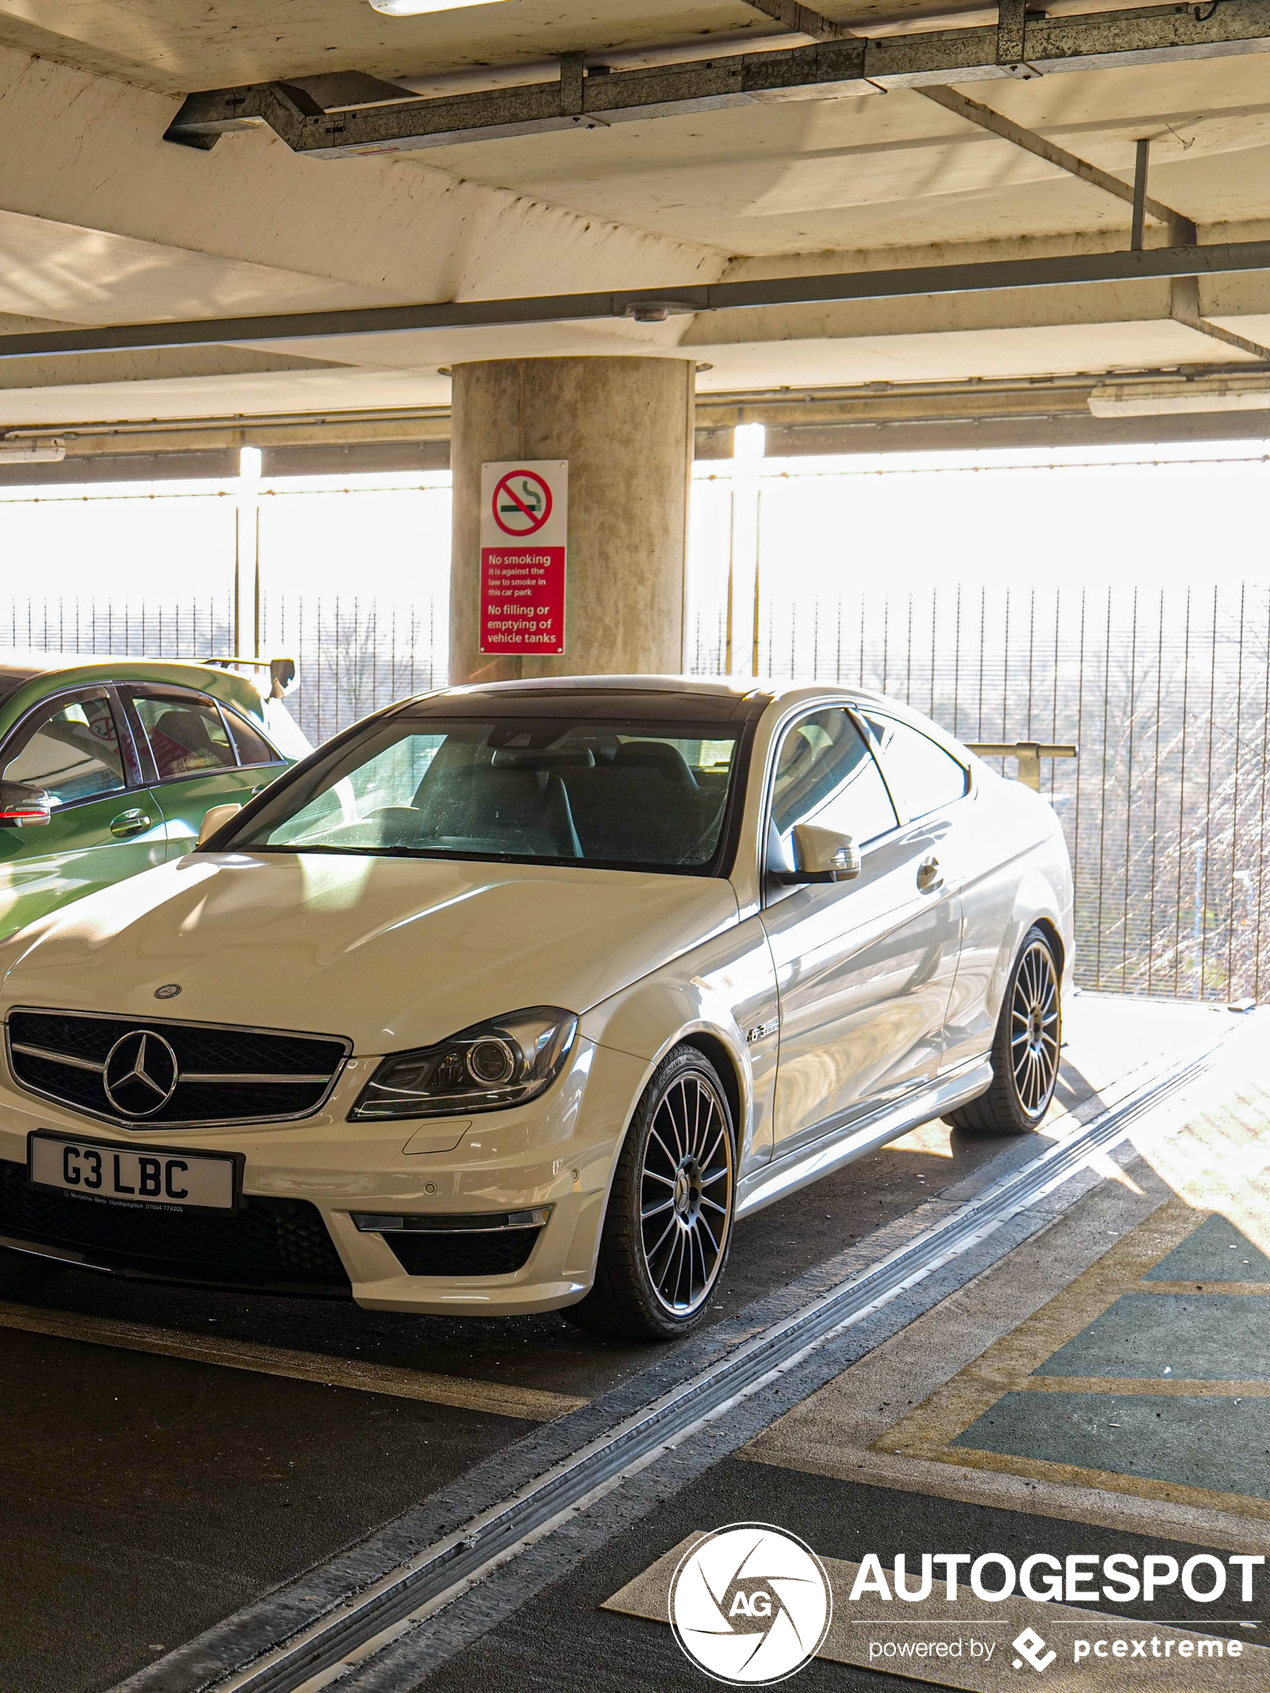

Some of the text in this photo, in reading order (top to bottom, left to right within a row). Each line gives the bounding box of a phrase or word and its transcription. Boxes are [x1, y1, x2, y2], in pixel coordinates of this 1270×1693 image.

[488, 555, 551, 566] No smoking
[502, 568, 529, 576] against
[538, 577, 546, 585] in
[488, 588, 501, 596] this
[514, 588, 532, 597] park
[488, 605, 550, 617] No filling or
[487, 619, 553, 632] emptying of
[488, 633, 557, 643] vehicle tanks
[63, 1145, 189, 1200] G3 LBC
